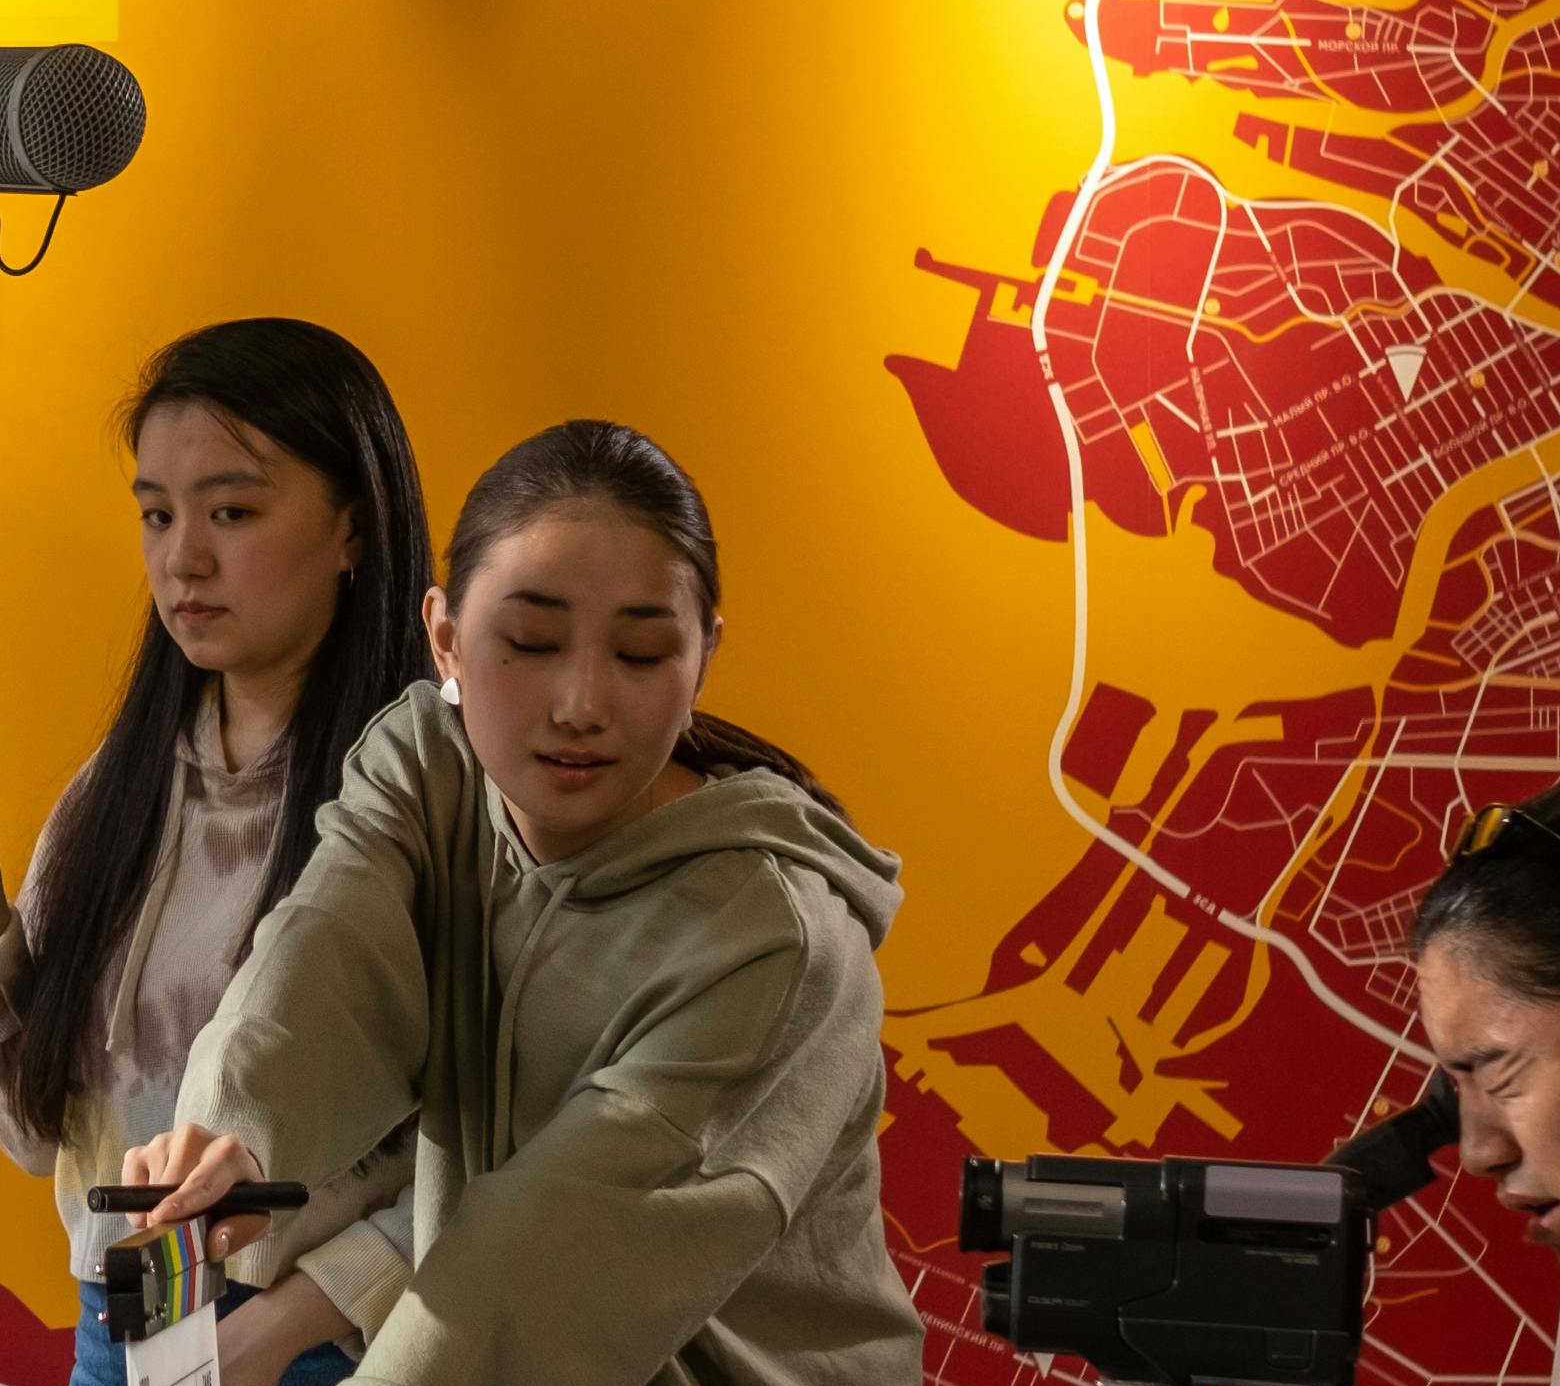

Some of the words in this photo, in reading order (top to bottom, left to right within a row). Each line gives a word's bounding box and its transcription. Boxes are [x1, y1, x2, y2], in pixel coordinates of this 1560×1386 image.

[1317, 38, 1379, 53] МОРСКОЙ
[1269, 395, 1315, 430] МАЛЫЙ
[1429, 417, 1490, 461] БОЛЬШОЙ
[1274, 447, 1333, 488] СРЕДНИЙ
[1190, 891, 1218, 916] ЗСД
[917, 1308, 989, 1349] ЛЕНИНСКИЙ
